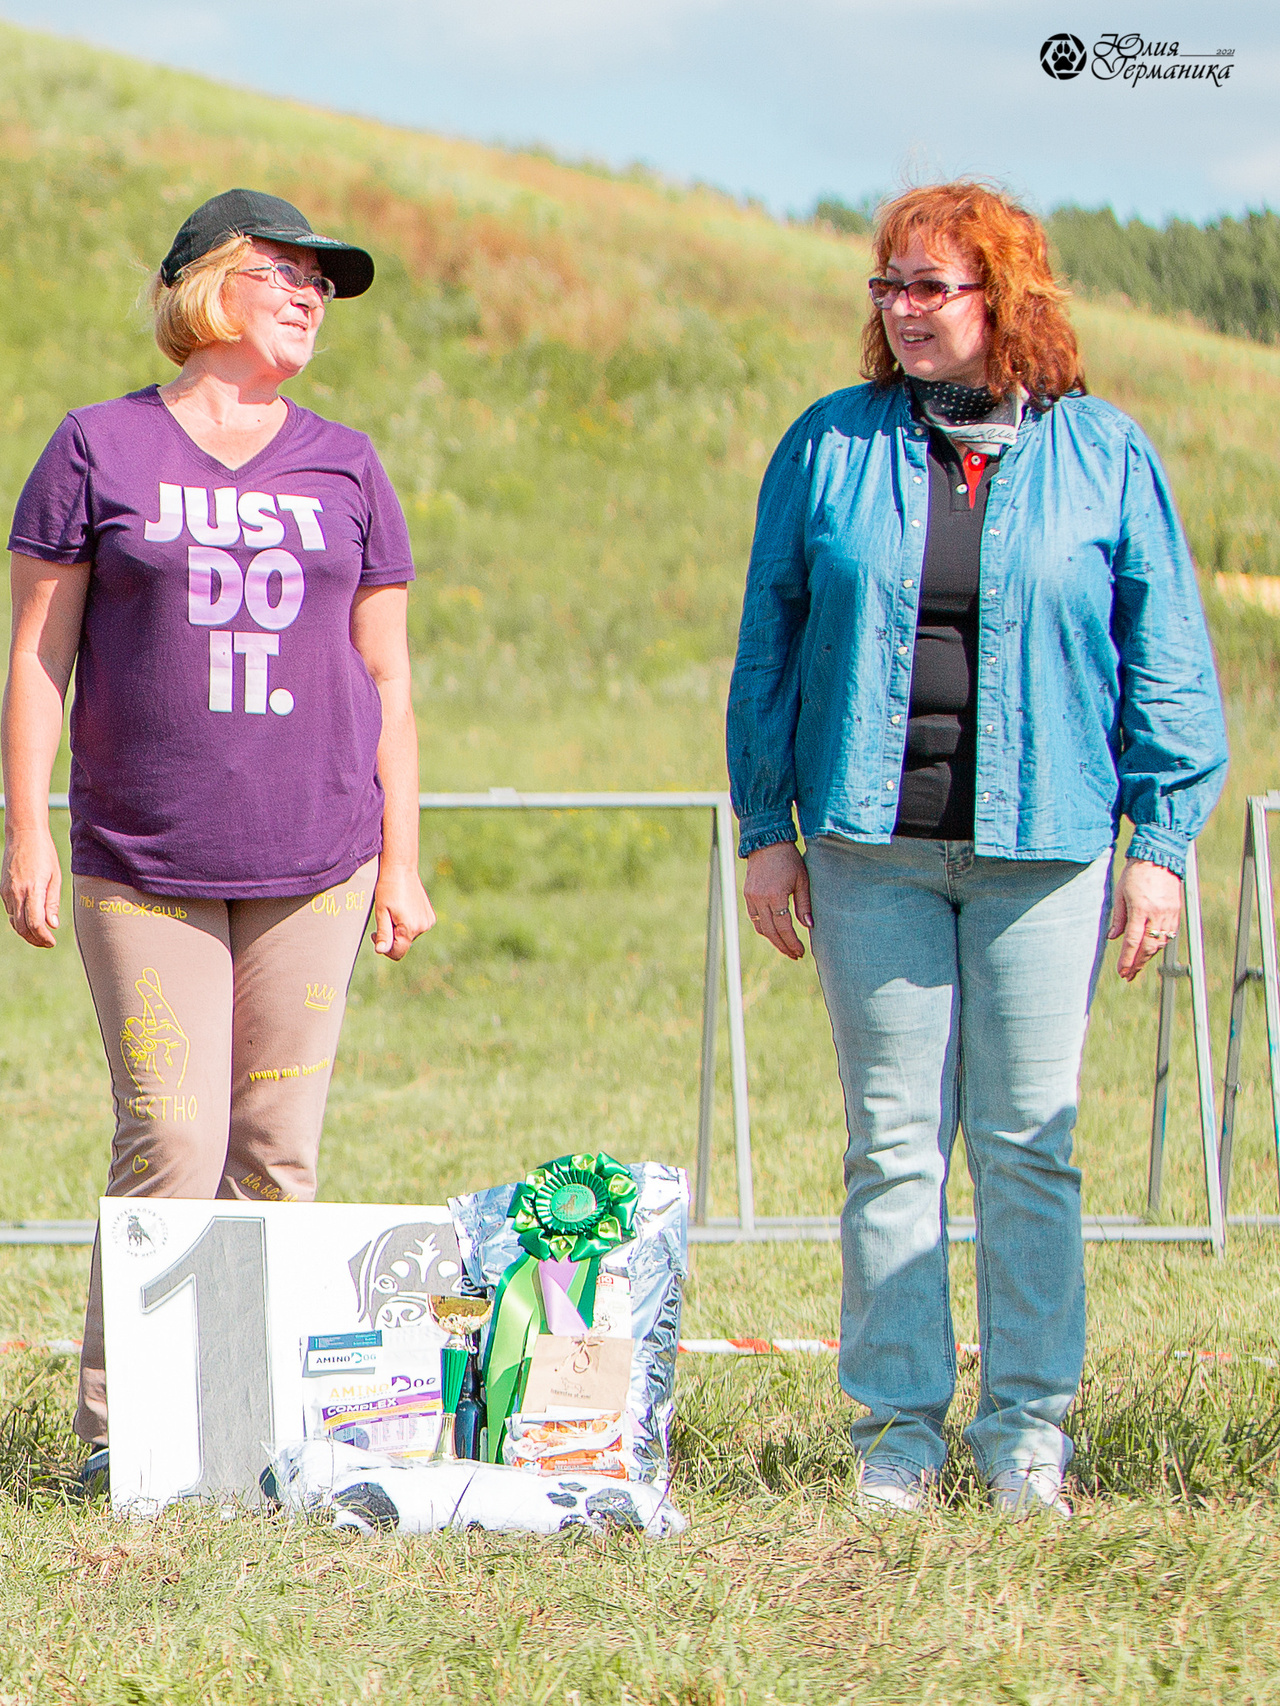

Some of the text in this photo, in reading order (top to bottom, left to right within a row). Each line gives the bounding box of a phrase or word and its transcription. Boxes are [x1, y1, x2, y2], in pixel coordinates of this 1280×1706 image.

[144, 481, 327, 550] JUST
[188, 545, 306, 630] DO
[209, 630, 295, 716] IT.
[249, 1069, 280, 1082] young
[281, 1065, 300, 1078] and
[125, 1094, 198, 1122] ЧЕСТНО
[241, 1173, 262, 1191] bla
[261, 1184, 280, 1200] bla
[140, 1215, 276, 1507] 1
[327, 1398, 399, 1417] COMPLEX
